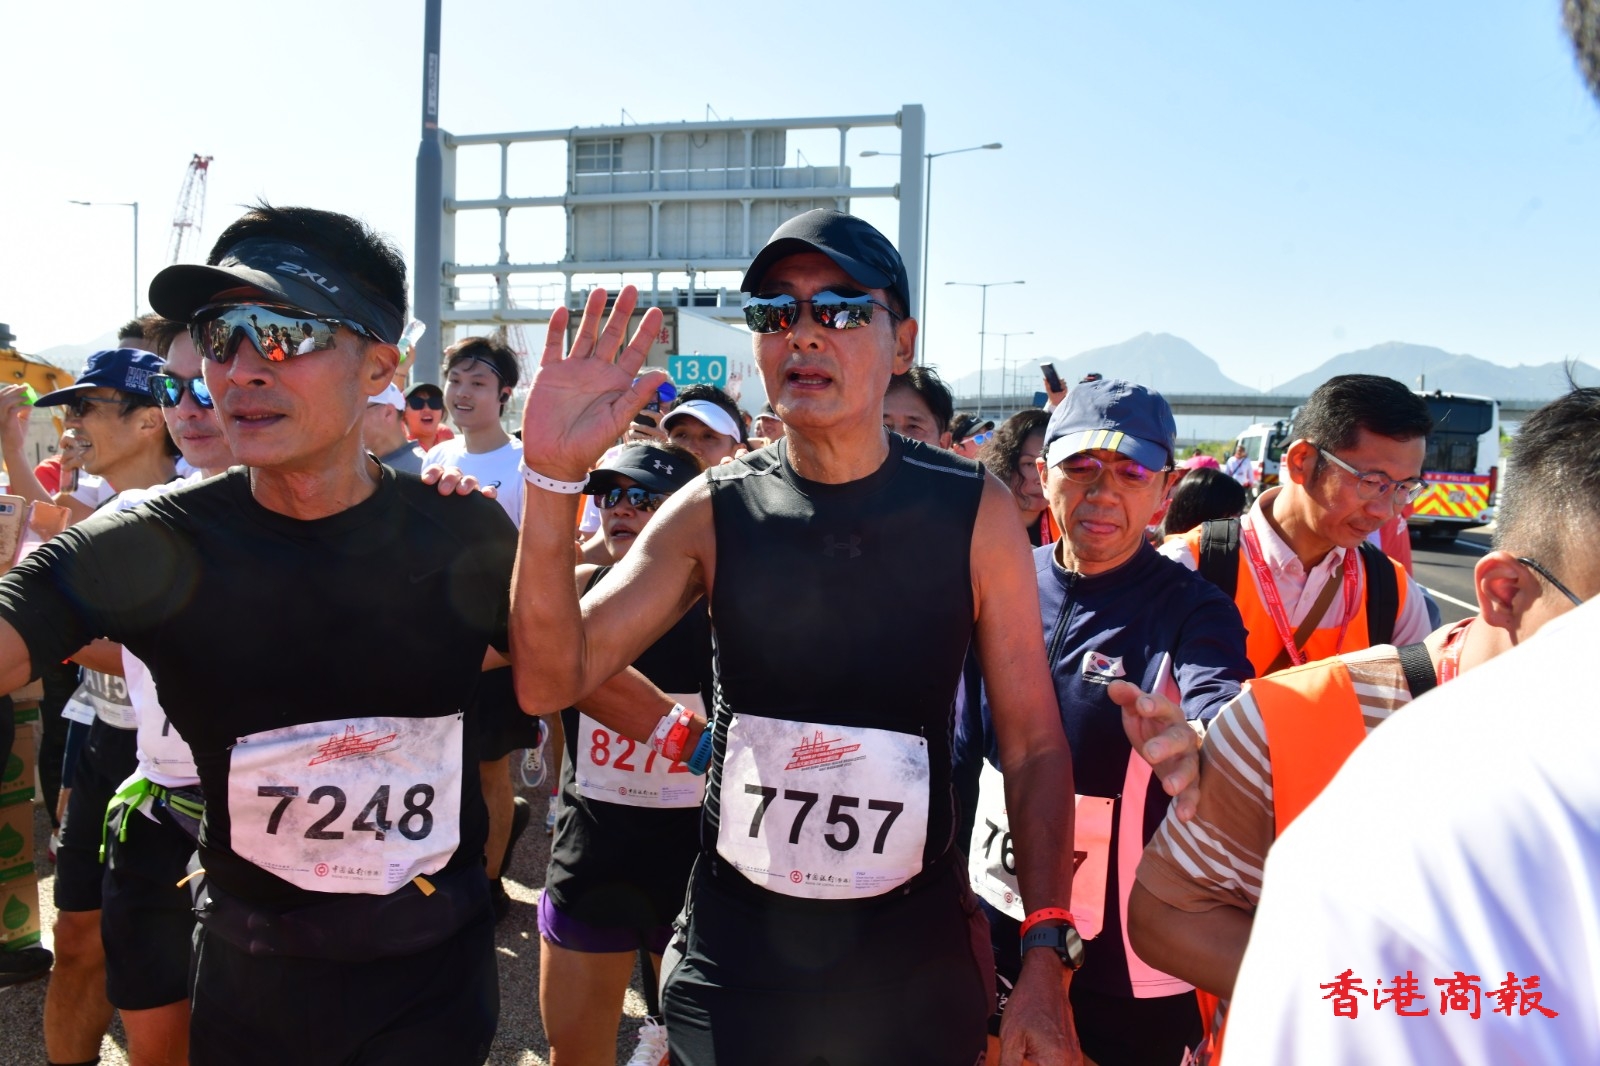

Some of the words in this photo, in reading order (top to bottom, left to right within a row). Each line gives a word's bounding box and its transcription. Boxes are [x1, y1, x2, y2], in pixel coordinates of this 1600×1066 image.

[276, 261, 340, 293] 2XU
[674, 360, 723, 381] 13.0
[257, 783, 435, 841] 7248
[744, 783, 904, 855] 7757
[982, 817, 1088, 875] 767
